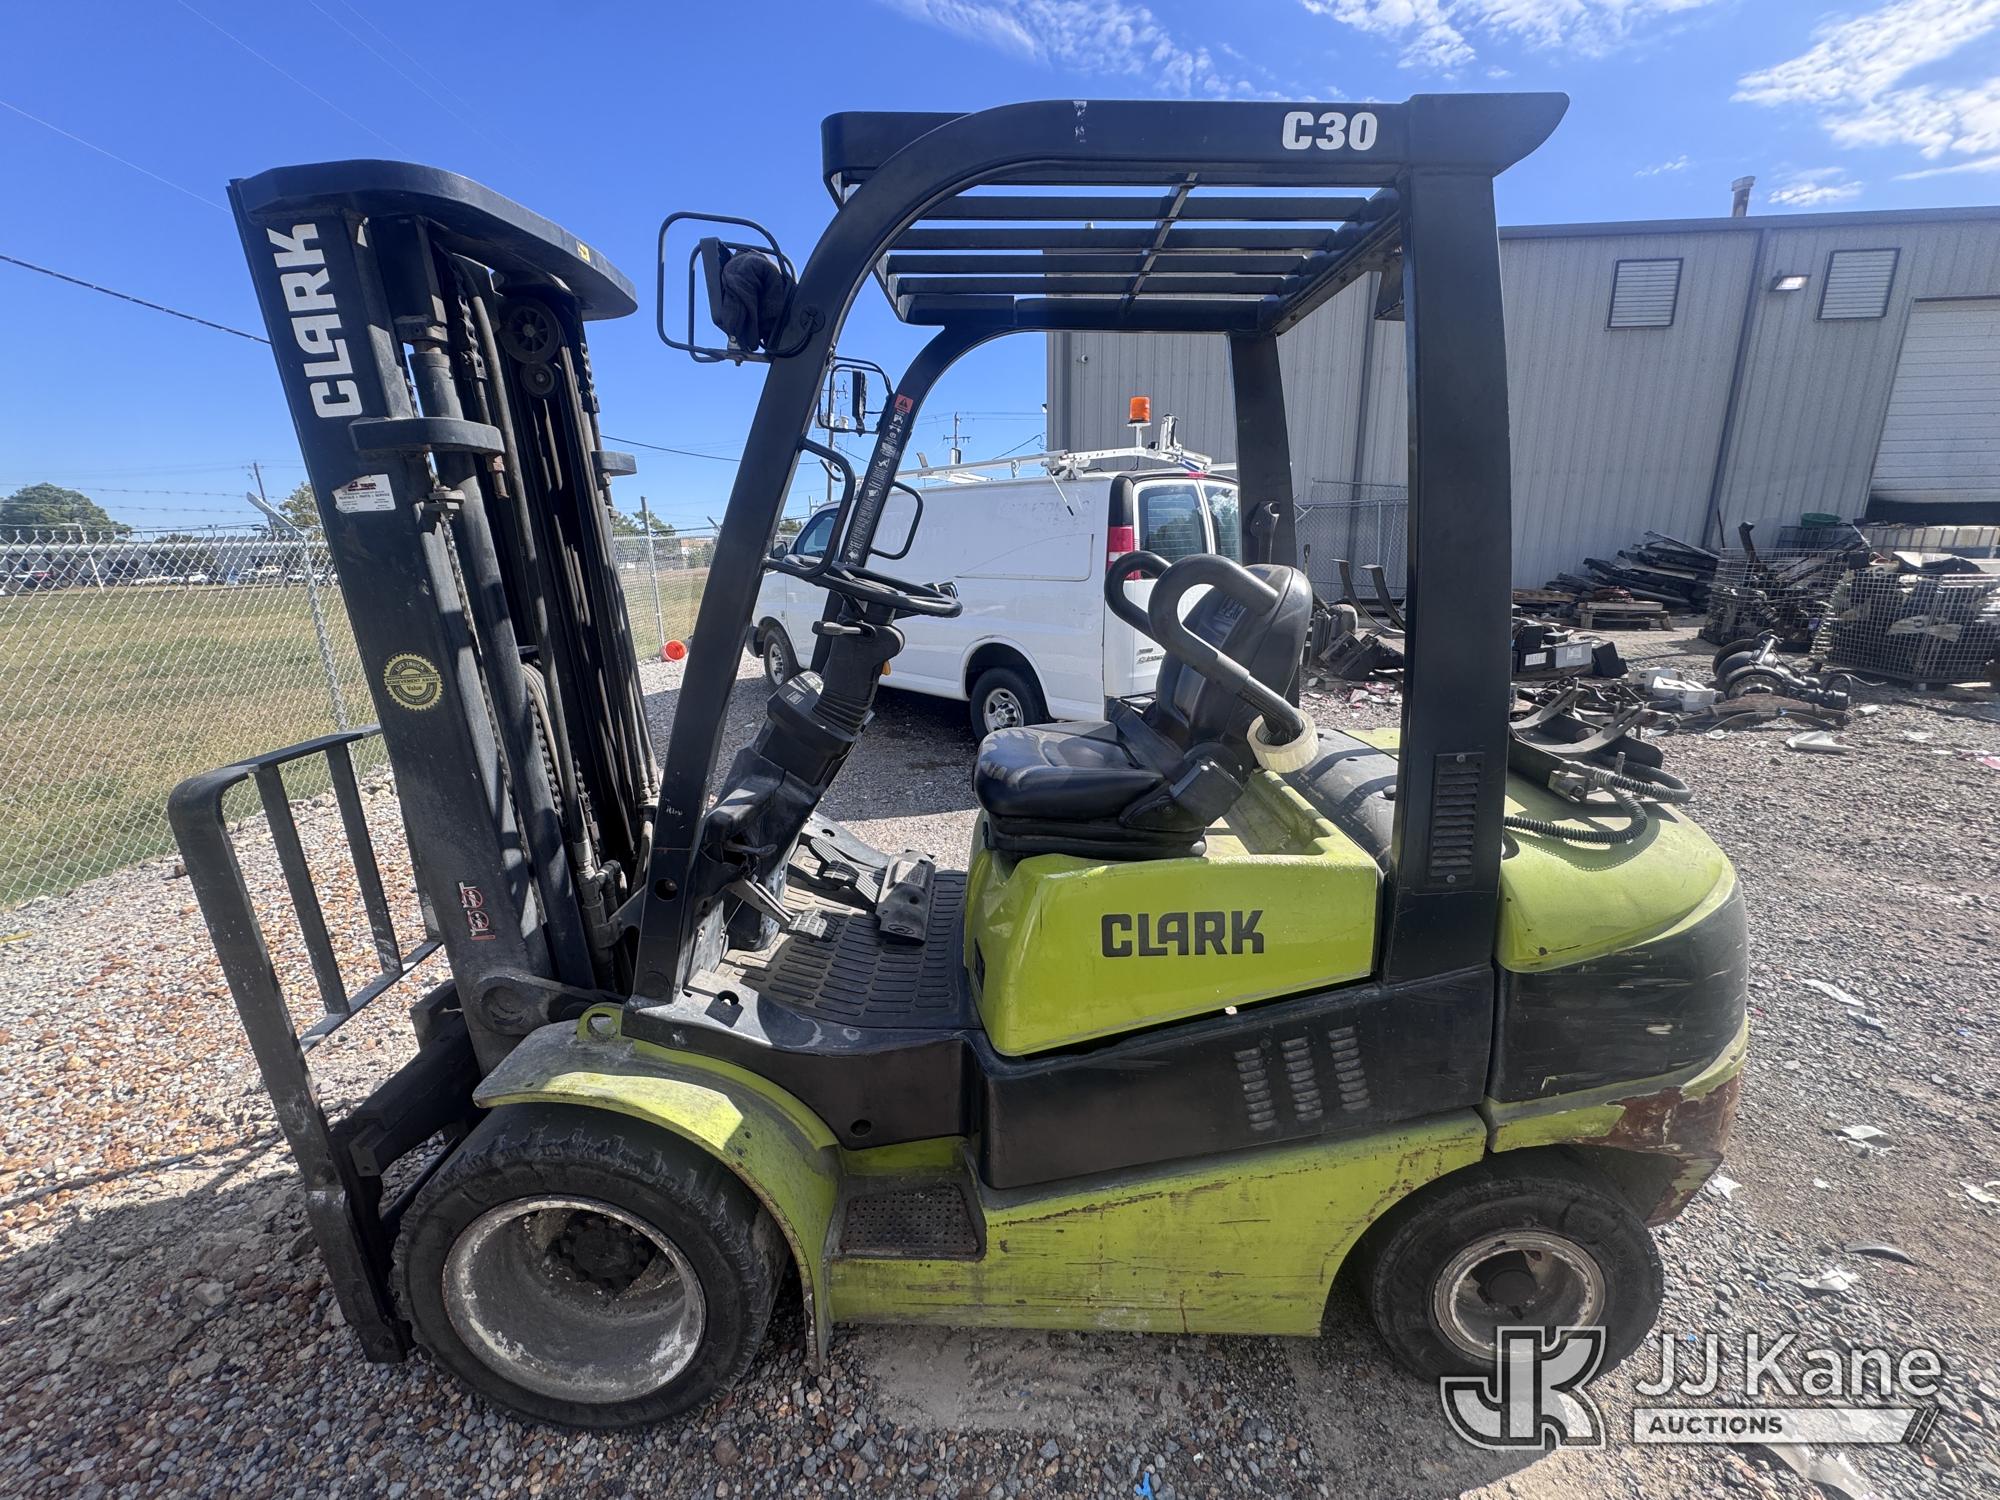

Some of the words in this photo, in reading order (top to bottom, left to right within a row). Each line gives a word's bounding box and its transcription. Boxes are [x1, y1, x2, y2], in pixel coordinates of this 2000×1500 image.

[1282, 111, 1378, 151] C30
[266, 223, 362, 418] CLARK
[1101, 910, 1264, 957] CLARK
